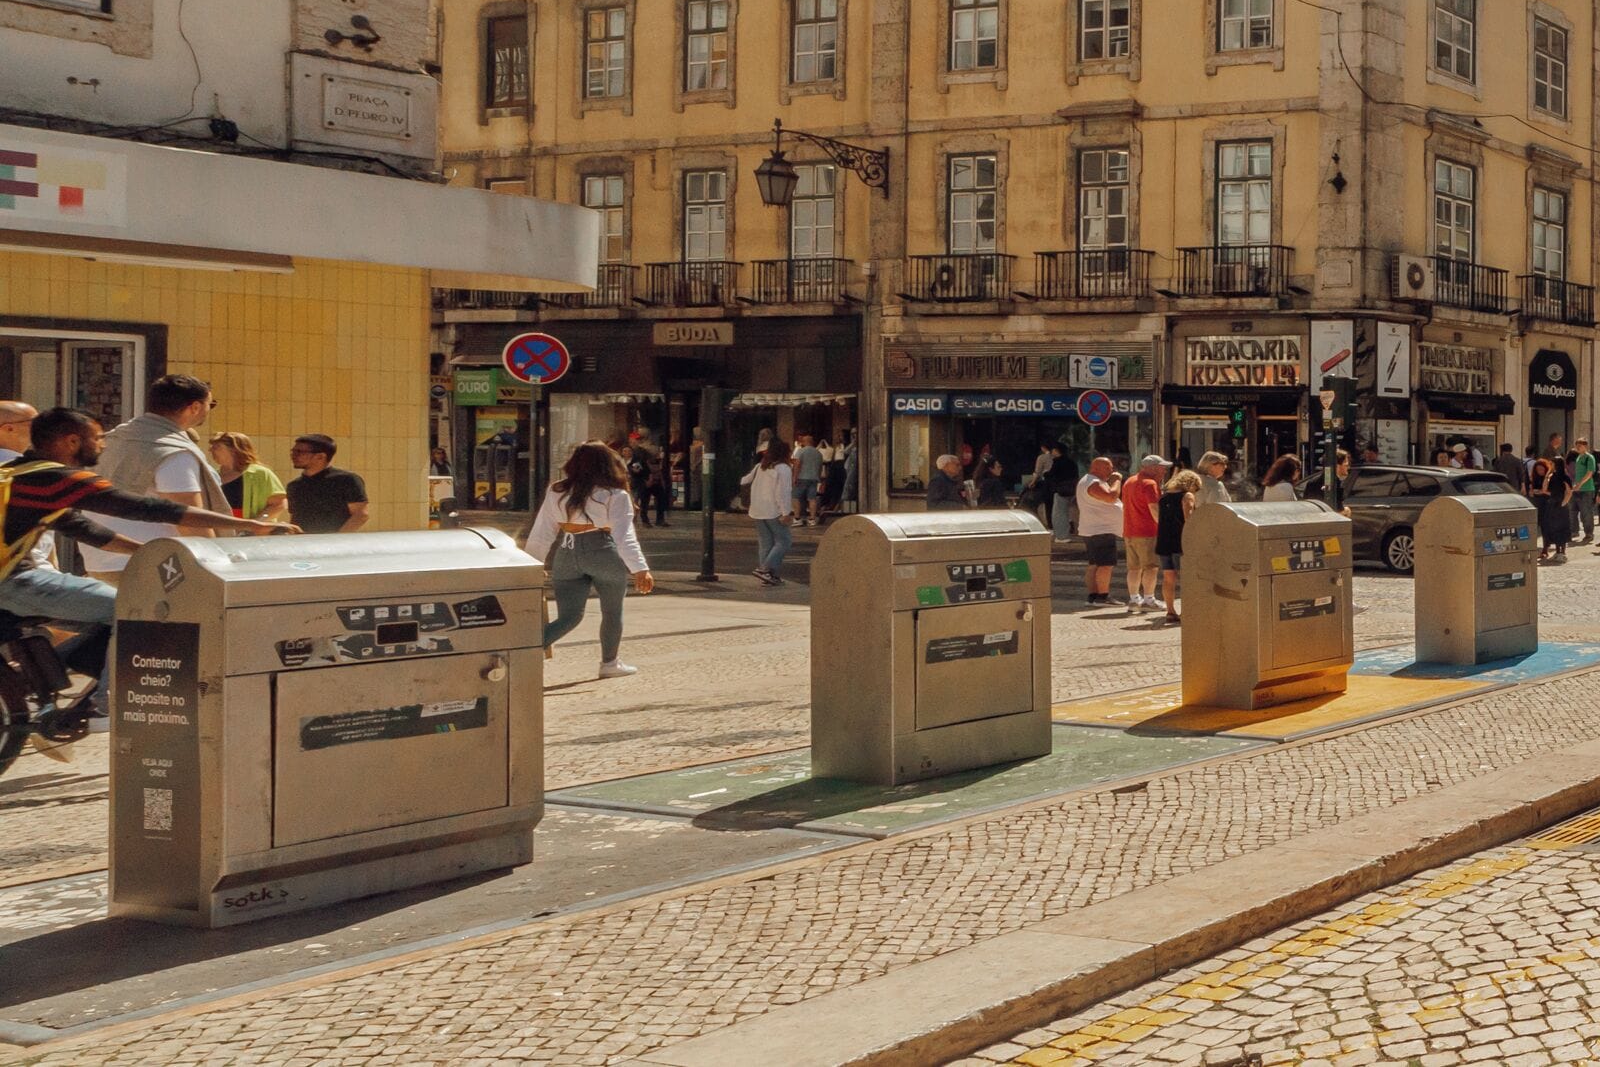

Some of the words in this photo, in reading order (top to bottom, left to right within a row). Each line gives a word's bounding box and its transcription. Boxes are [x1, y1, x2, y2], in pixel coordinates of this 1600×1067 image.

[349, 92, 390, 108] PRAÇA
[391, 115, 405, 126] IV
[666, 325, 721, 342] BUDA
[1188, 339, 1300, 361] TABACARIA
[921, 355, 1027, 379] FUJIFILM
[1191, 364, 1266, 385] ROSSIO
[456, 381, 491, 394] OURO
[894, 398, 943, 412] CASIO
[994, 398, 1045, 413] CASIO
[1110, 399, 1148, 413] ASIO
[1235, 411, 1243, 421] 12
[131, 654, 182, 670] Contentor
[140, 673, 172, 687] cheio?
[127, 690, 170, 707] Deposite
[172, 696, 185, 707] no
[123, 708, 146, 722] mais
[148, 711, 190, 726] próximo.
[141, 757, 157, 767] VEJA
